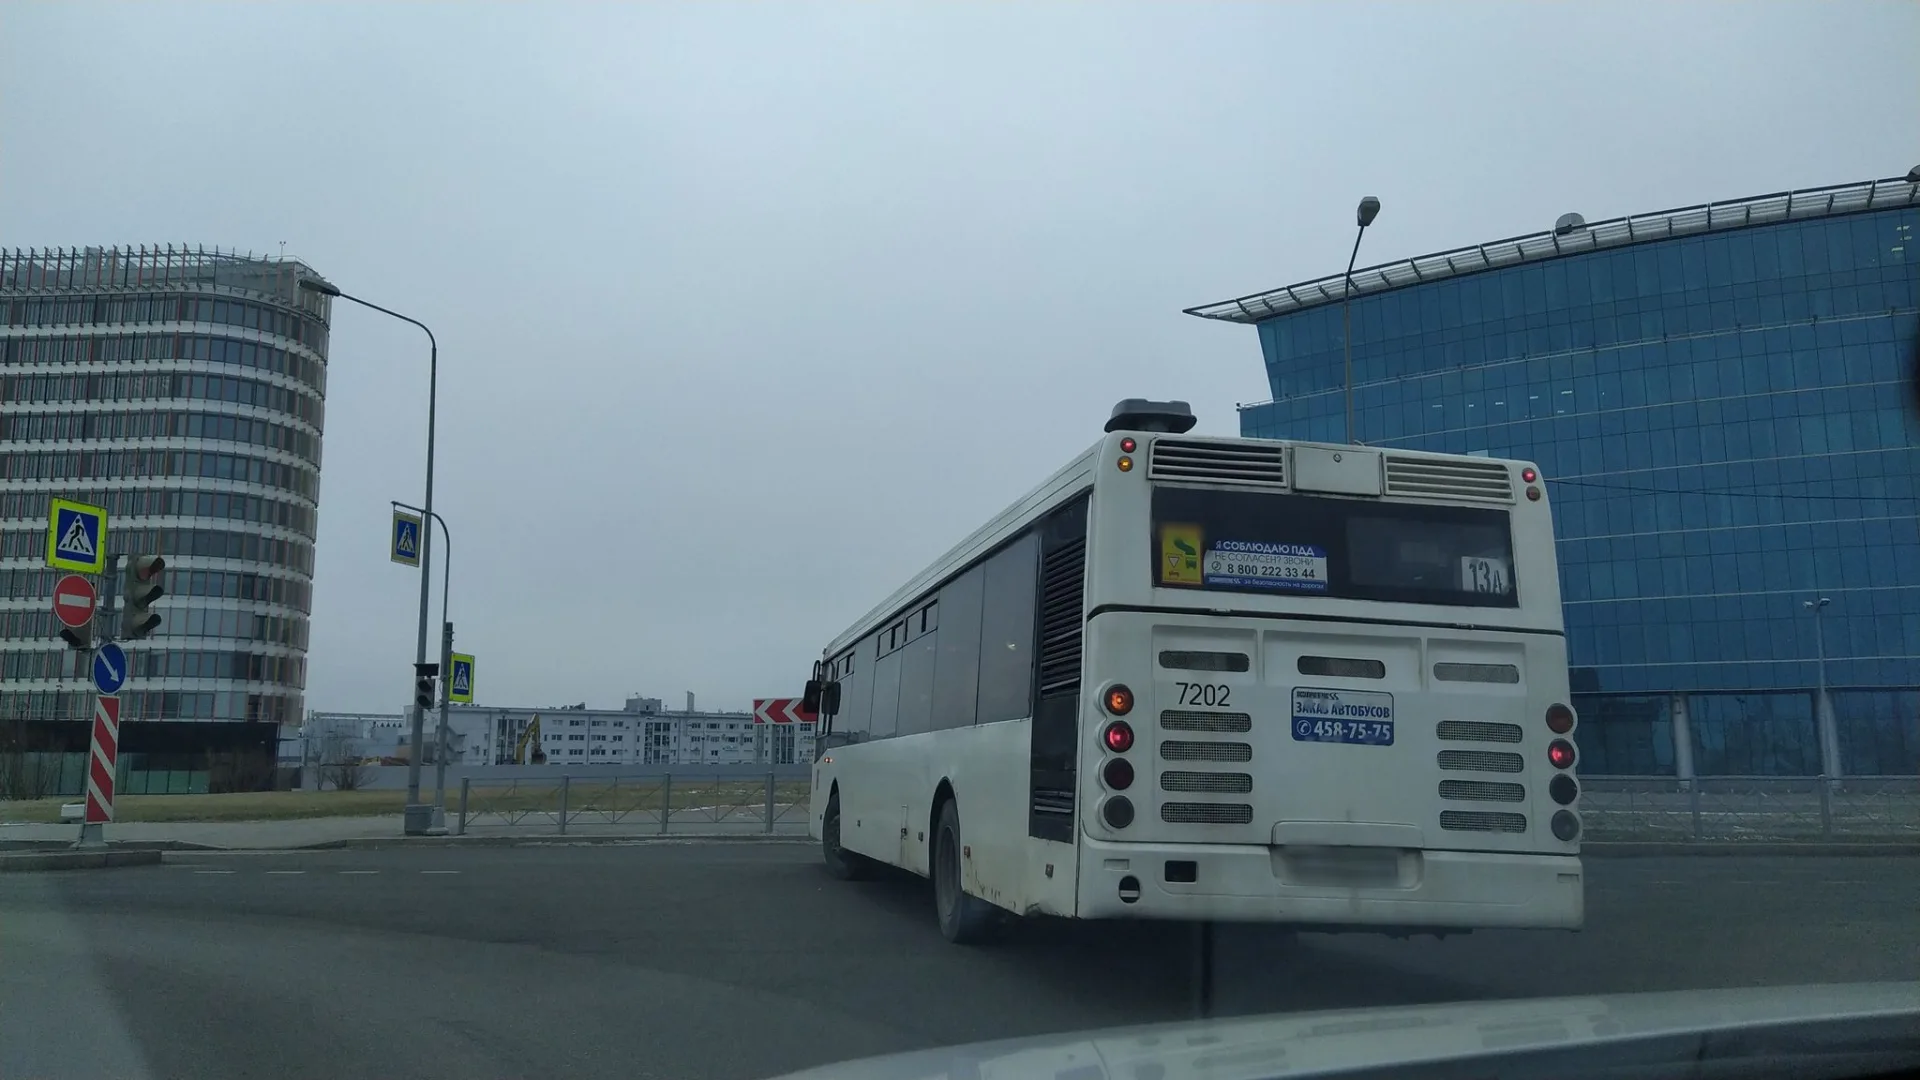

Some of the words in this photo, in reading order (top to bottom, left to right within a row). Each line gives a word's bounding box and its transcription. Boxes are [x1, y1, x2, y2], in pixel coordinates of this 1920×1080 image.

[1215, 540, 1222, 549] Я
[1223, 541, 1290, 554] СОБЛЮДАЮ
[1292, 545, 1315, 556] ПДД
[1214, 551, 1227, 560] НЕ
[1228, 552, 1281, 564] СОГЛАСЕН?
[1283, 556, 1314, 566] ЗВОНИ
[1227, 563, 1234, 574] 8
[1237, 564, 1258, 575] 800
[1261, 566, 1282, 577] 222
[1285, 567, 1299, 578] 33
[1301, 568, 1316, 579] 44
[1175, 682, 1231, 707] 7202
[1331, 704, 1391, 719] АВТОБУСОВ
[1313, 720, 1391, 740] 458-75-75
